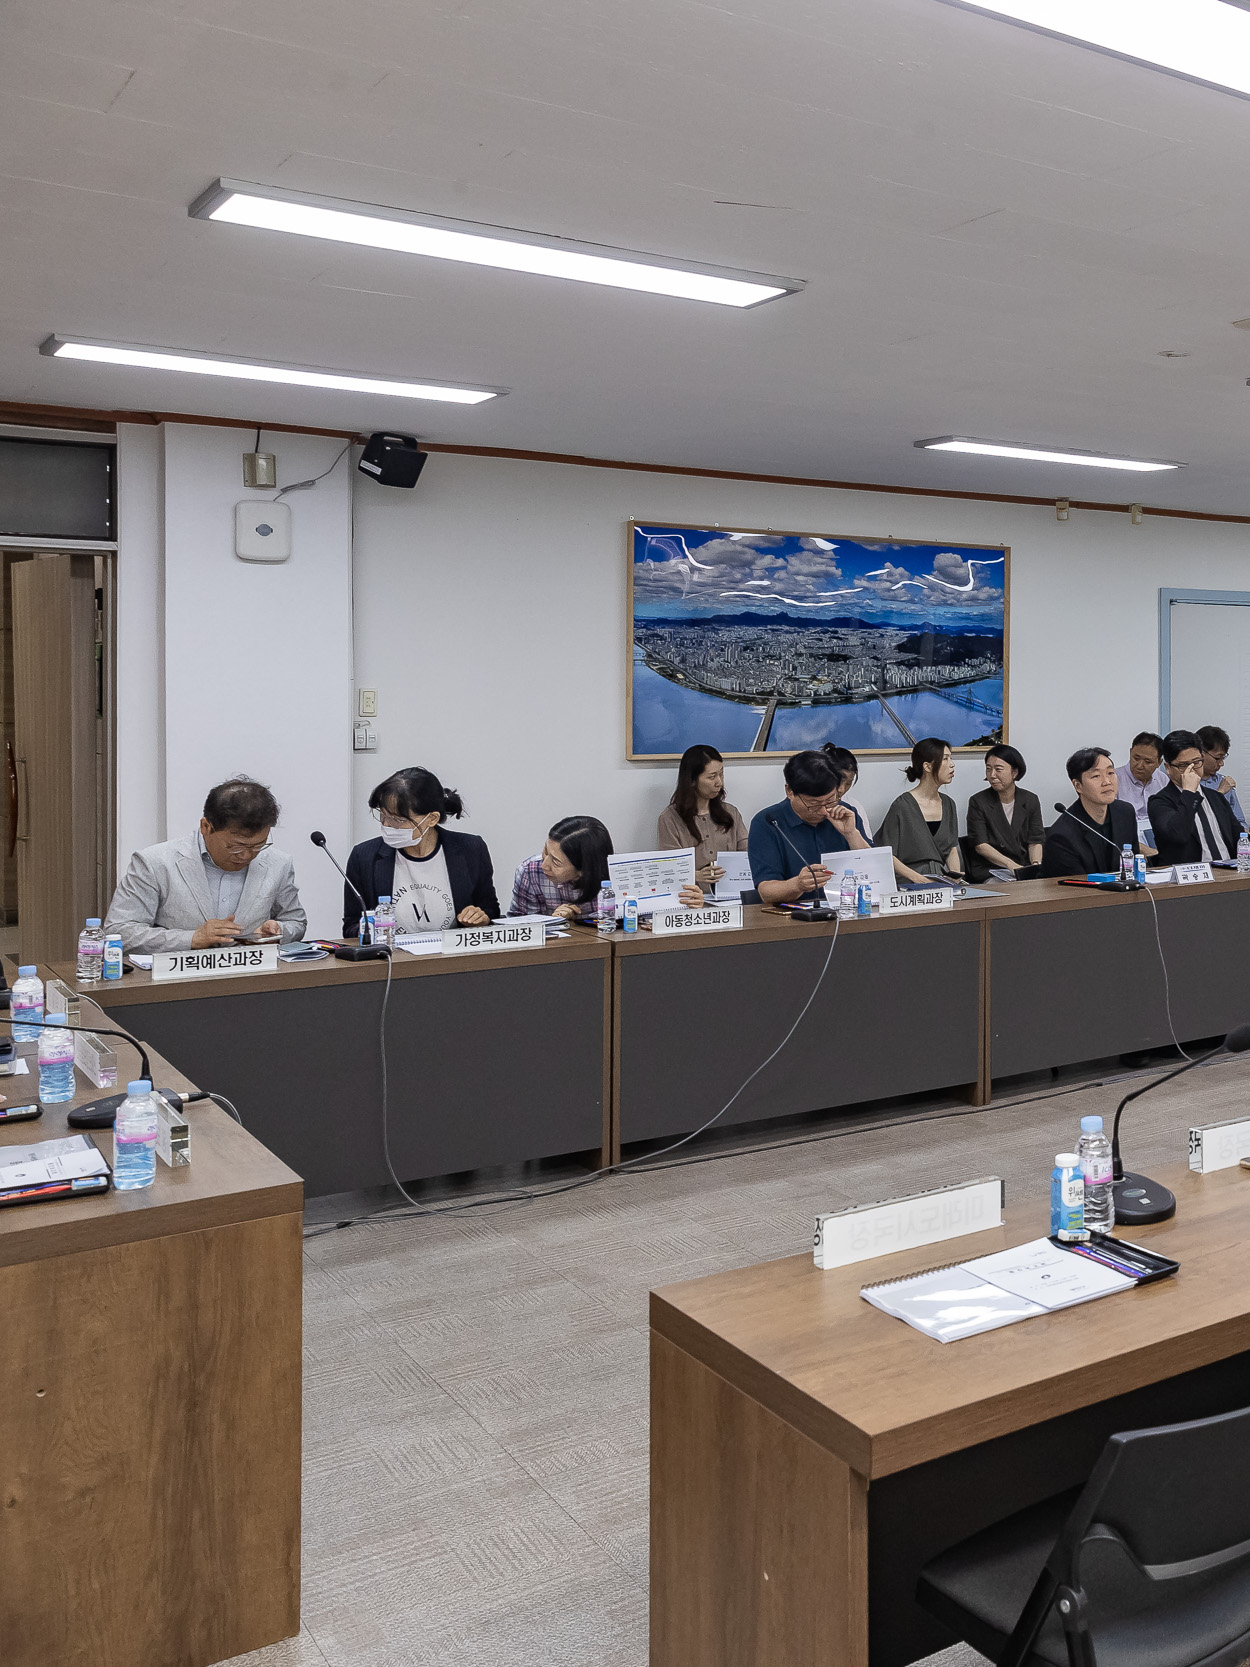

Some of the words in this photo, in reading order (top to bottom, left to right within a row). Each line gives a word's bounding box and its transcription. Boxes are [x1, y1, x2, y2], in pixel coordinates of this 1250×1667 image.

[410, 883, 441, 894] EQUALITY
[441, 893, 453, 911] GOES
[889, 891, 943, 909] 도시계획과장
[664, 910, 731, 929] 아동청소년과장
[455, 927, 533, 948] 가정복지과장
[168, 949, 264, 972] 기획예산과장
